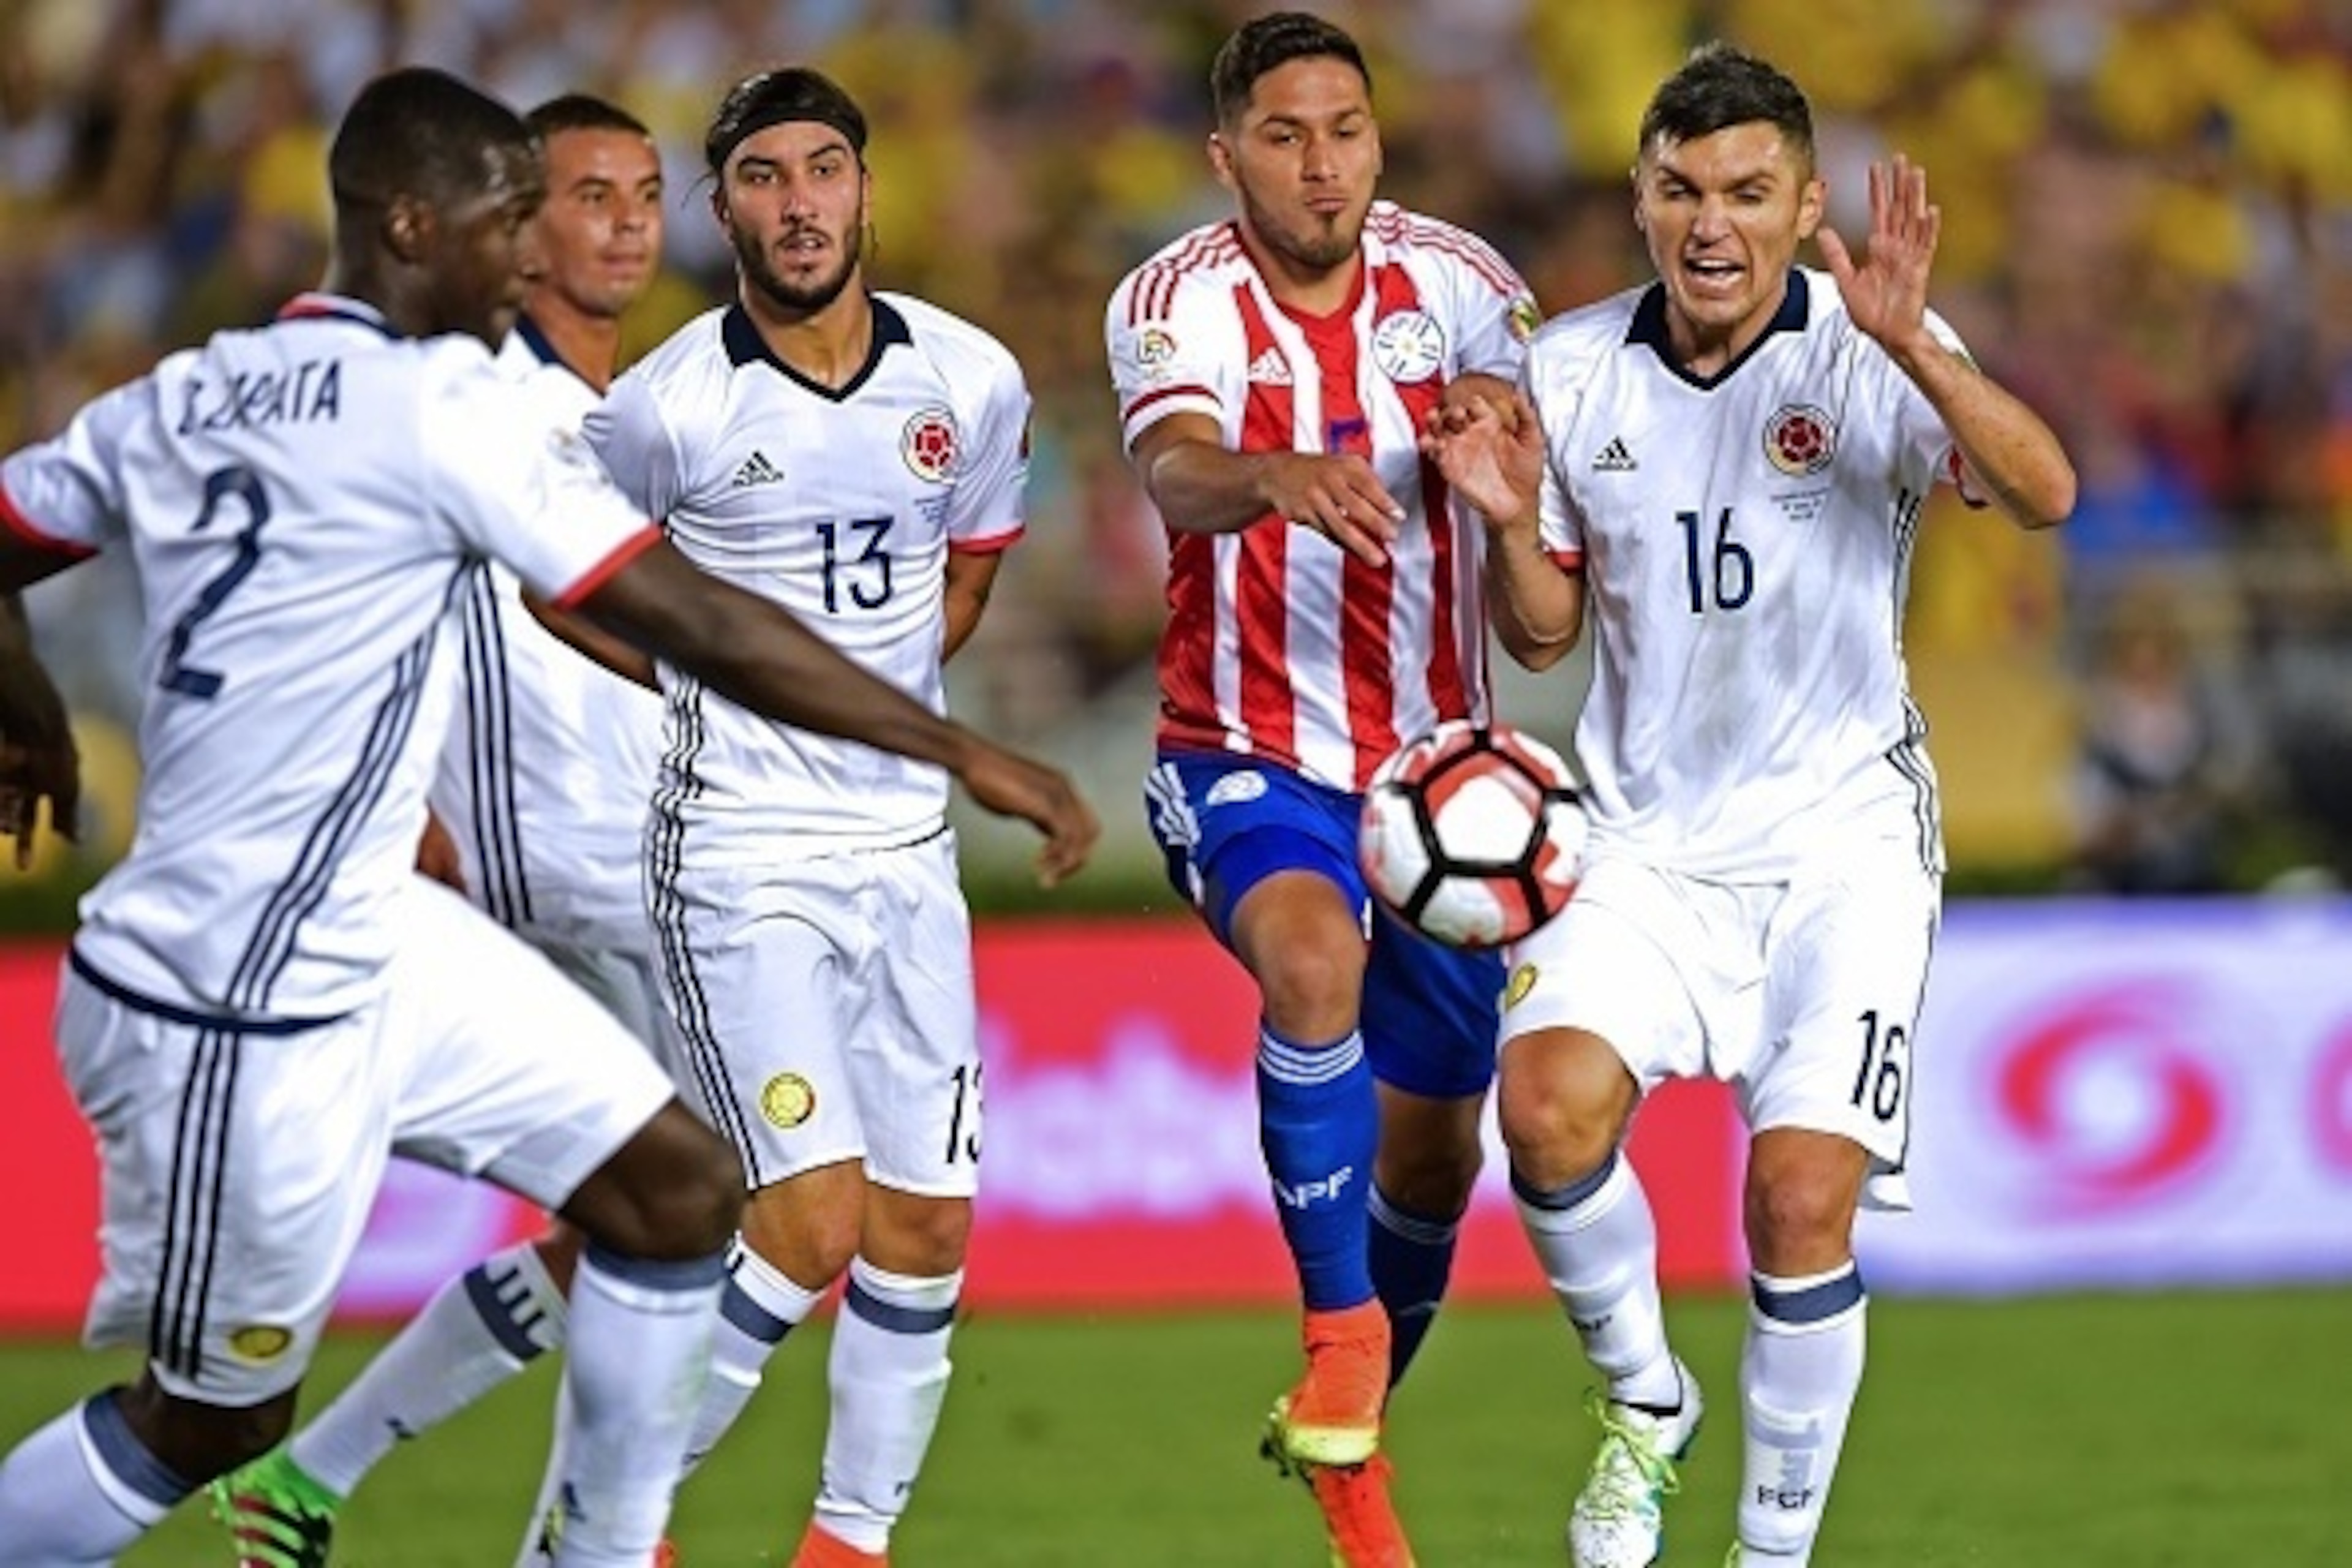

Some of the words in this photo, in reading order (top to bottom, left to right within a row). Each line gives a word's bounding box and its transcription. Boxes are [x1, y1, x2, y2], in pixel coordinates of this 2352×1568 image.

[159, 466, 271, 702] 2
[816, 515, 895, 613] 13
[1675, 507, 1754, 614] 16
[1849, 1009, 1905, 1123] 16
